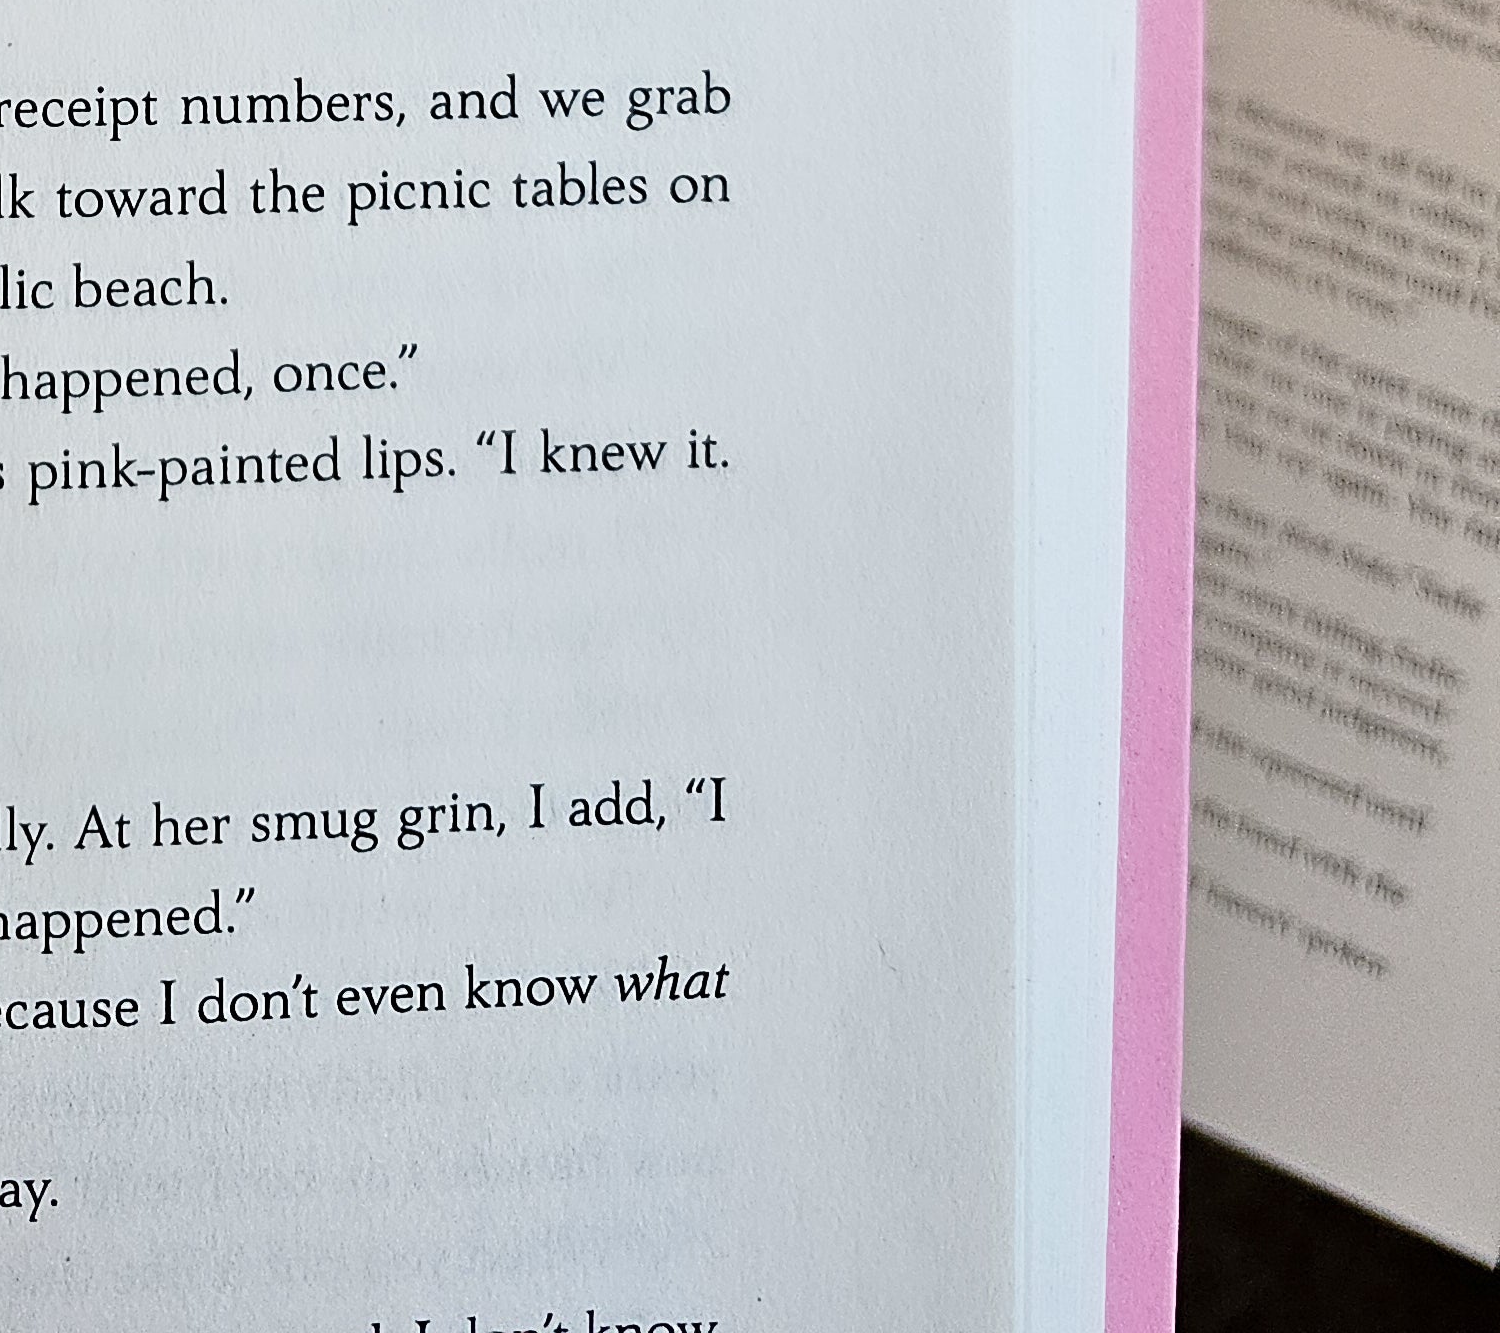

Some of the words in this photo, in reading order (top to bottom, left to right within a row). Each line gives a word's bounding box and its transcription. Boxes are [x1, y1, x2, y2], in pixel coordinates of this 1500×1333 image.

[180, 76, 406, 128] numbers,
[429, 72, 519, 121] and
[538, 88, 605, 119] we
[625, 68, 731, 132] grab
[55, 168, 228, 219] toward
[249, 167, 325, 215] the
[347, 168, 491, 227] picnic
[511, 159, 648, 209] tables
[669, 174, 731, 204] on
[72, 259, 228, 309] beach.
[0, 347, 253, 415] happened,
[273, 342, 418, 393] once.”
[27, 434, 342, 507] pink-painted
[362, 433, 456, 494] lips.
[476, 429, 517, 475] “I
[539, 427, 668, 474] knew
[687, 428, 729, 469] it.
[73, 804, 131, 851] At
[151, 800, 231, 847] her
[251, 808, 379, 854] smug
[397, 792, 506, 851] grin,
[528, 782, 546, 829] I
[568, 778, 666, 832] add,
[685, 776, 727, 822] “I
[159, 979, 177, 1025] I
[197, 973, 319, 1025] don’t
[336, 982, 447, 1017] even
[464, 963, 598, 1010] know
[613, 954, 730, 1003] what
